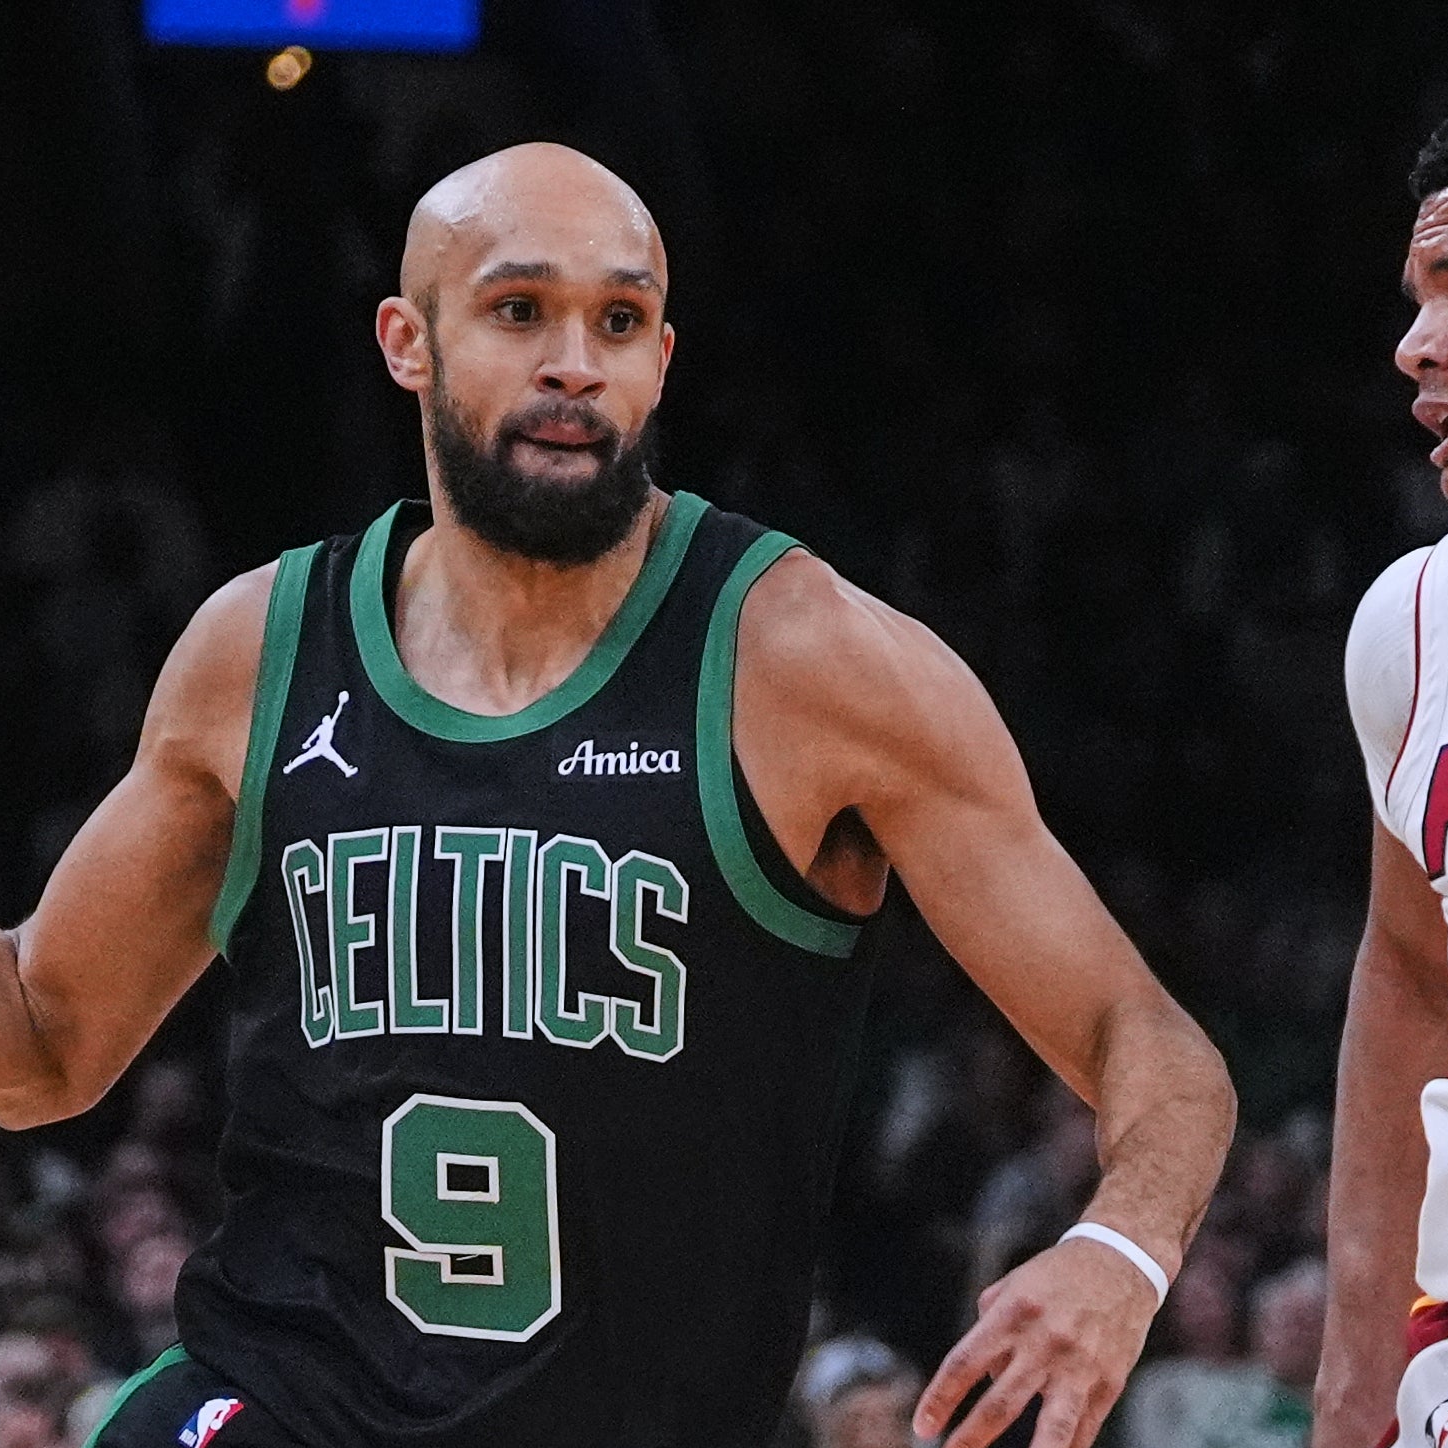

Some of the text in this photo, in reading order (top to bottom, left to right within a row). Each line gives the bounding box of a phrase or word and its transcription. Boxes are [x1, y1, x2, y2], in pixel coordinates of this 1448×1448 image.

[557, 739, 682, 777] Amica
[281, 824, 689, 1064] CELTICS
[380, 1092, 561, 1343] 9
